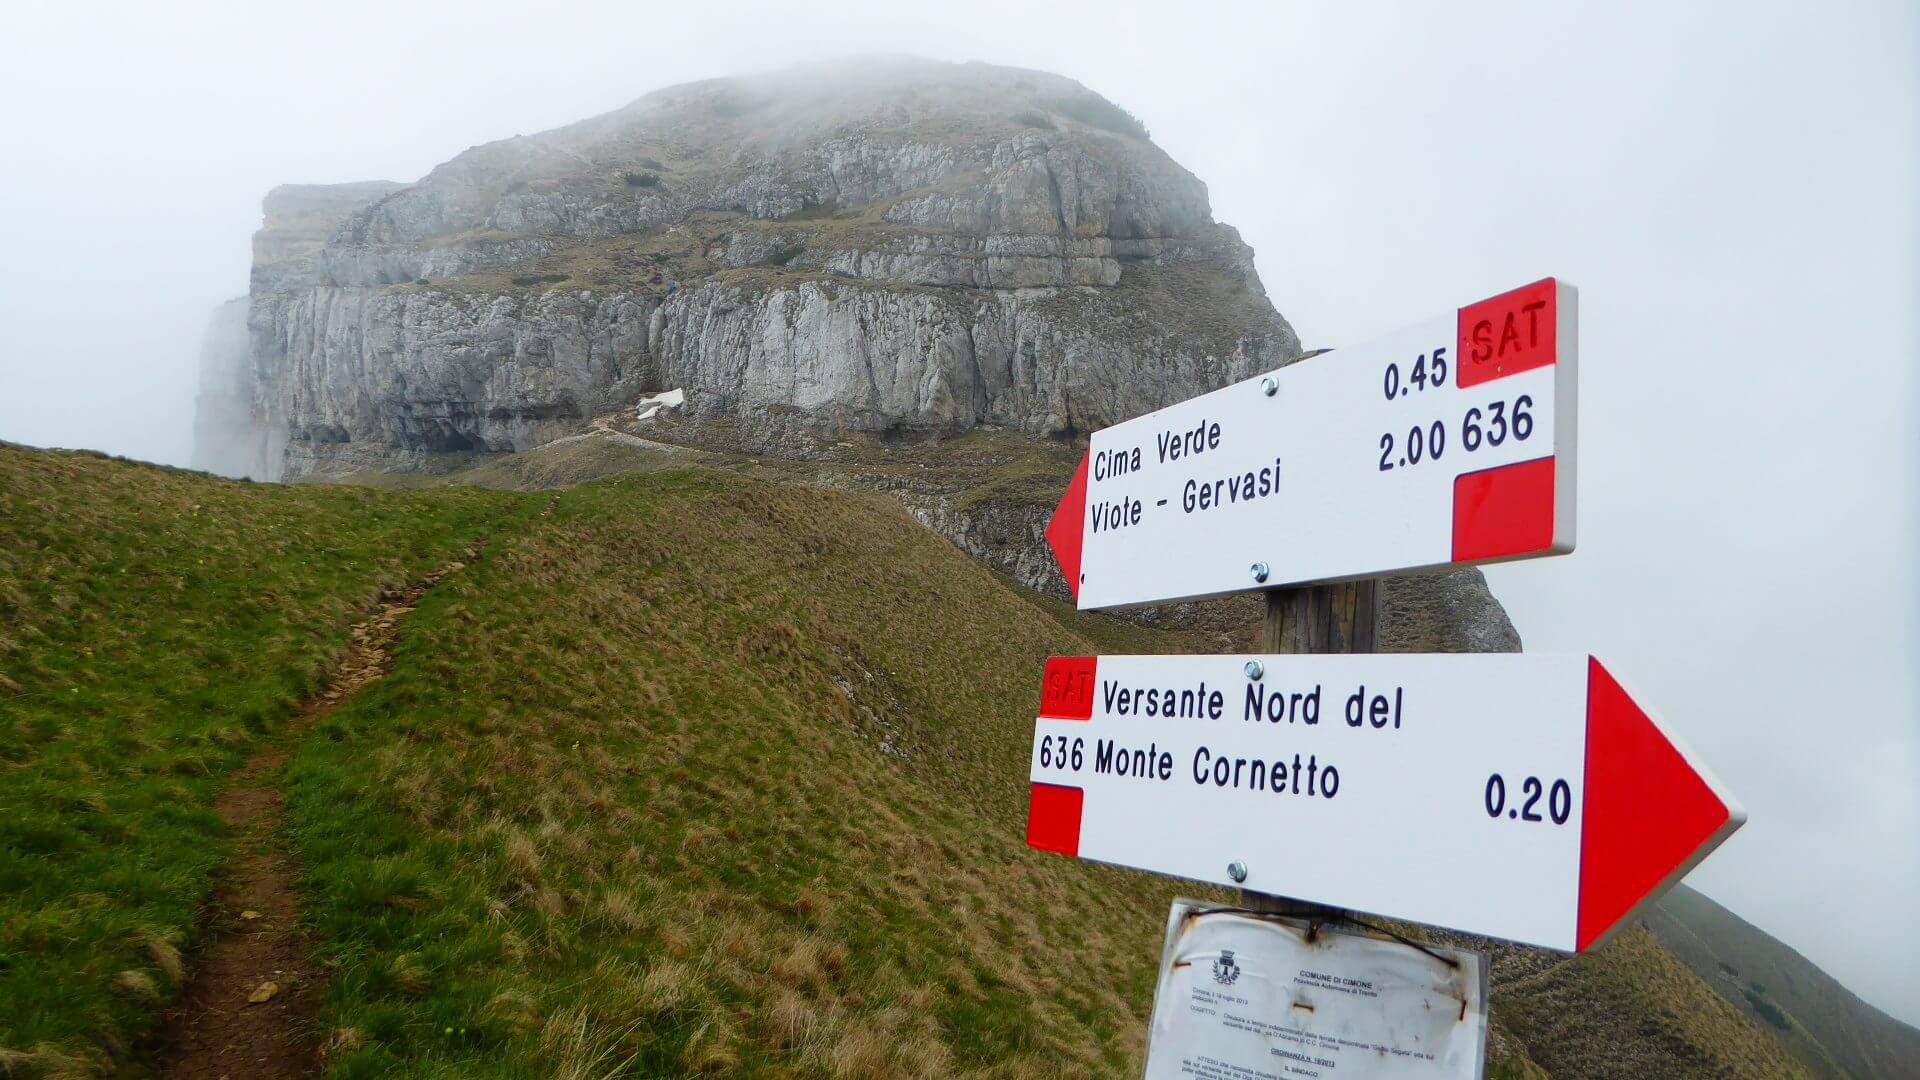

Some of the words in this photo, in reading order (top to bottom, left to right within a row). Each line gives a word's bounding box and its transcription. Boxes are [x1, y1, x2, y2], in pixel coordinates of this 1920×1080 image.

[1472, 301, 1546, 364] SAT
[1384, 347, 1447, 401] 0.45
[1094, 446, 1142, 482] Cima
[1157, 419, 1221, 464] Verde
[1379, 420, 1446, 472] 2.00
[1462, 394, 1534, 452] 636
[1091, 495, 1142, 534] Viote
[1183, 457, 1281, 514] Gervasi
[1047, 671, 1091, 704] SAT
[1103, 679, 1224, 721] Versante
[1244, 682, 1321, 726] Nord
[1345, 684, 1403, 729] del
[1040, 735, 1084, 772] 636
[1094, 738, 1173, 781] Monte
[1192, 746, 1340, 799] Cornetto
[1484, 773, 1572, 826] 0.20
[1293, 977, 1320, 988] Provincia
[1299, 970, 1331, 983] COMUNE
[1333, 976, 1341, 985] DI
[1343, 979, 1373, 990] CIMONE
